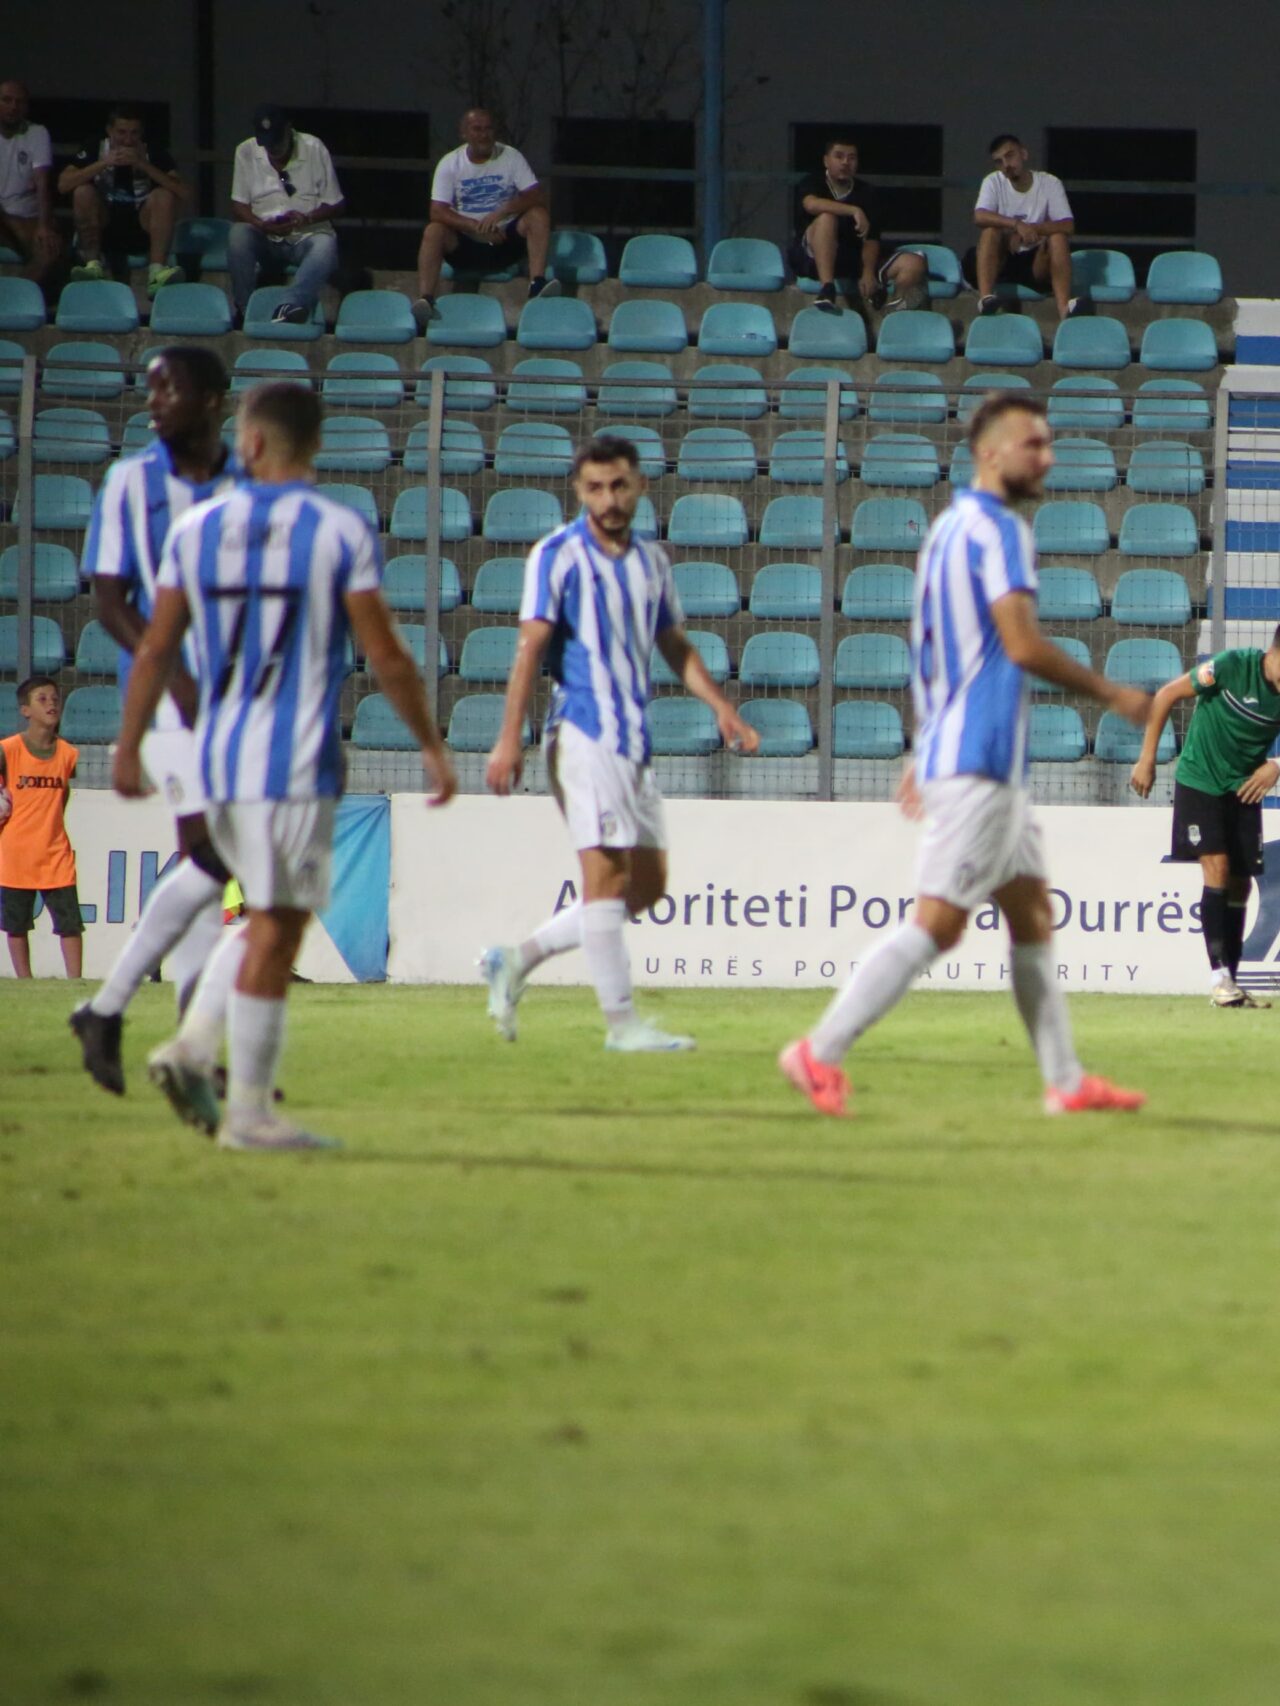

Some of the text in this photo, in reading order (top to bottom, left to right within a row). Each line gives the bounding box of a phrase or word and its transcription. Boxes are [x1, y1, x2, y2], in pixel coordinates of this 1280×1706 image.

[205, 584, 303, 704] 77
[553, 879, 809, 928] Aoriteti
[918, 962, 1139, 981] AUTHRITY
